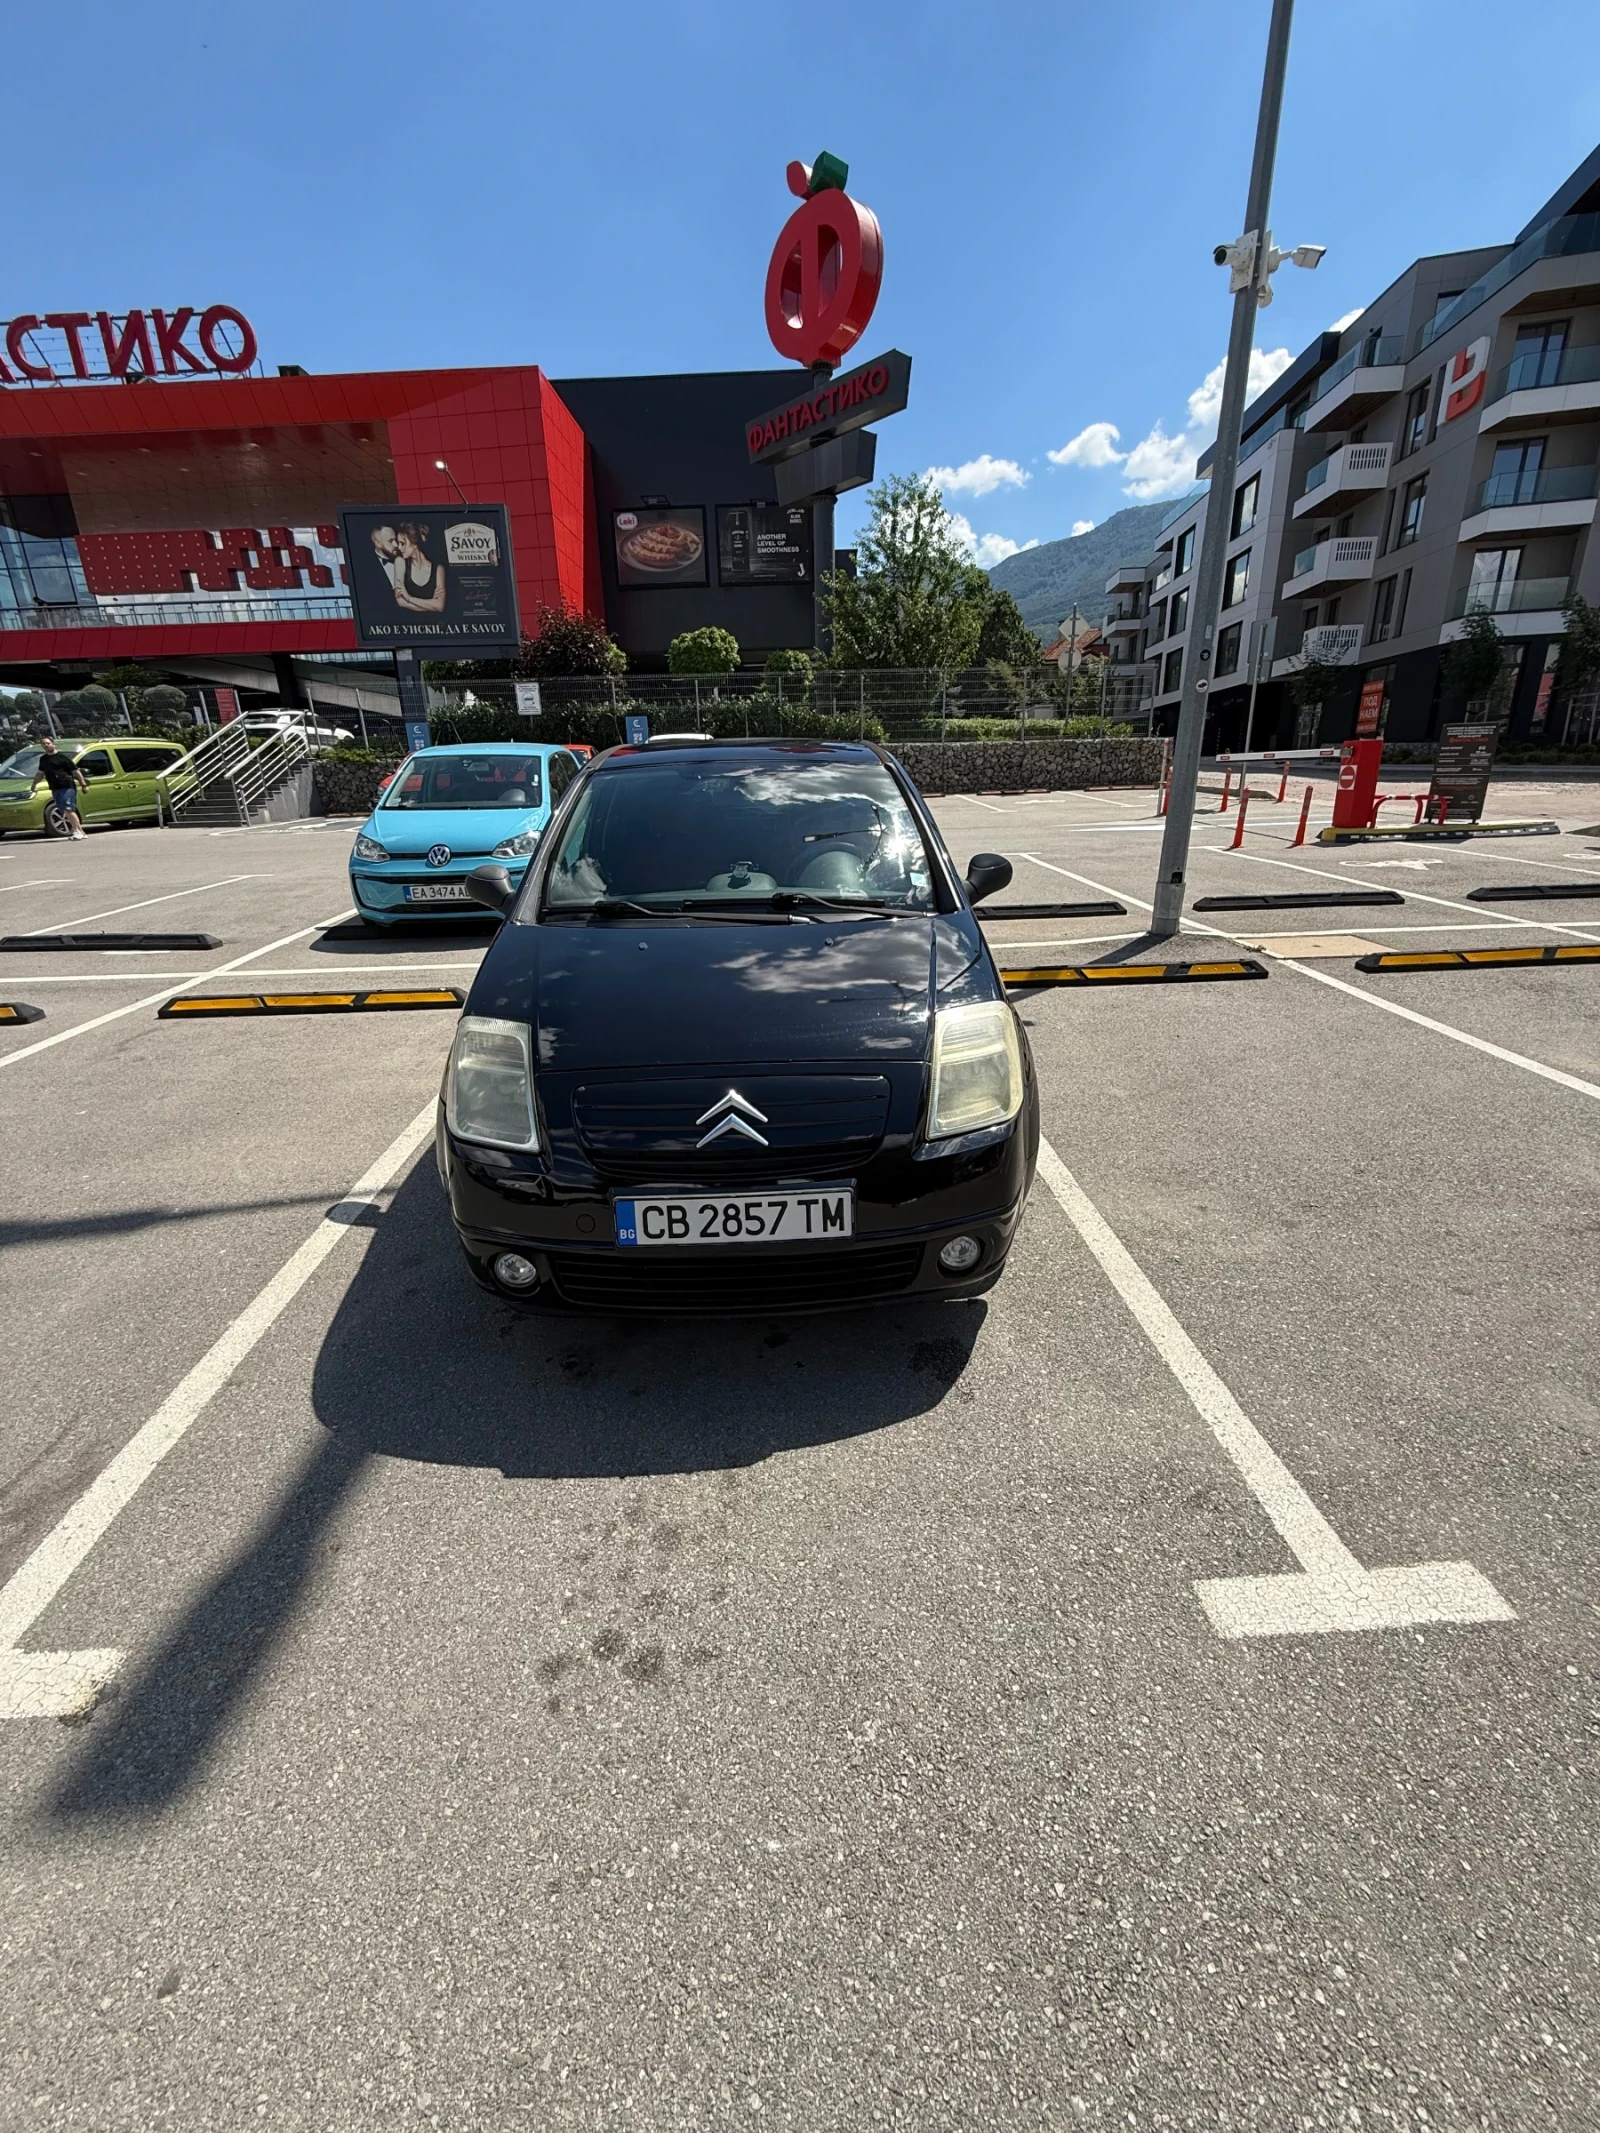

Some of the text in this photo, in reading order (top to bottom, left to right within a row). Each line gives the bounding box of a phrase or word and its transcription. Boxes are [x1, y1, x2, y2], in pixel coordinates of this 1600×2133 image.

[0, 304, 258, 384] СТИКО
[748, 364, 889, 453] ФАНТАСТИКО
[619, 518, 635, 526] Leki
[450, 536, 492, 552] SAVOY
[368, 625, 391, 635] АКО
[445, 624, 461, 635] ДА
[471, 623, 506, 633] SAVOY
[1363, 696, 1378, 707] ПОД
[1359, 708, 1379, 720] НАЕМ
[411, 887, 427, 899] EA
[429, 887, 456, 898] 3474
[642, 1197, 845, 1239] CB 2857 TM
[619, 1229, 636, 1240] BG
